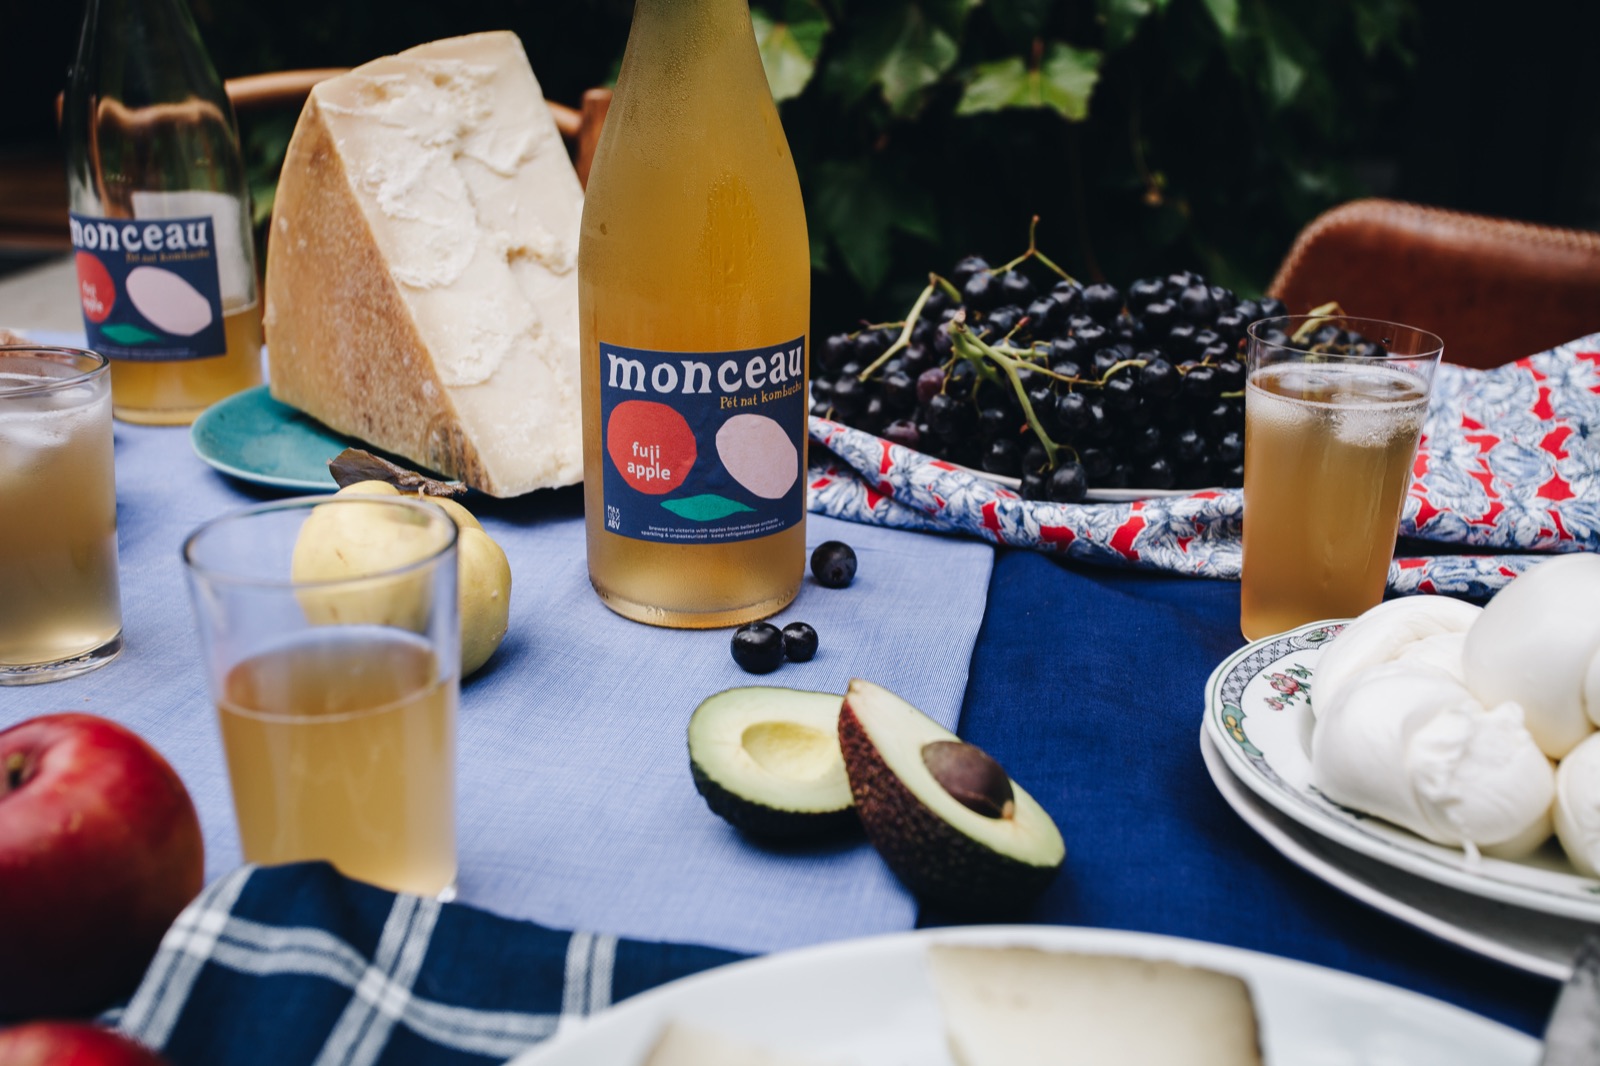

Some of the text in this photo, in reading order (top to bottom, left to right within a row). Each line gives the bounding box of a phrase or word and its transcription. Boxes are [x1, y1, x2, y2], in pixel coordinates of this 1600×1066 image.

[69, 217, 208, 252] monceau
[606, 346, 802, 394] monceau
[720, 396, 738, 409] Pét
[740, 394, 758, 407] nat
[632, 441, 660, 466] fuji
[627, 461, 671, 482] apple
[607, 504, 620, 513] MAX
[641, 530, 664, 538] sparkling
[725, 529, 755, 538] refrigerated
